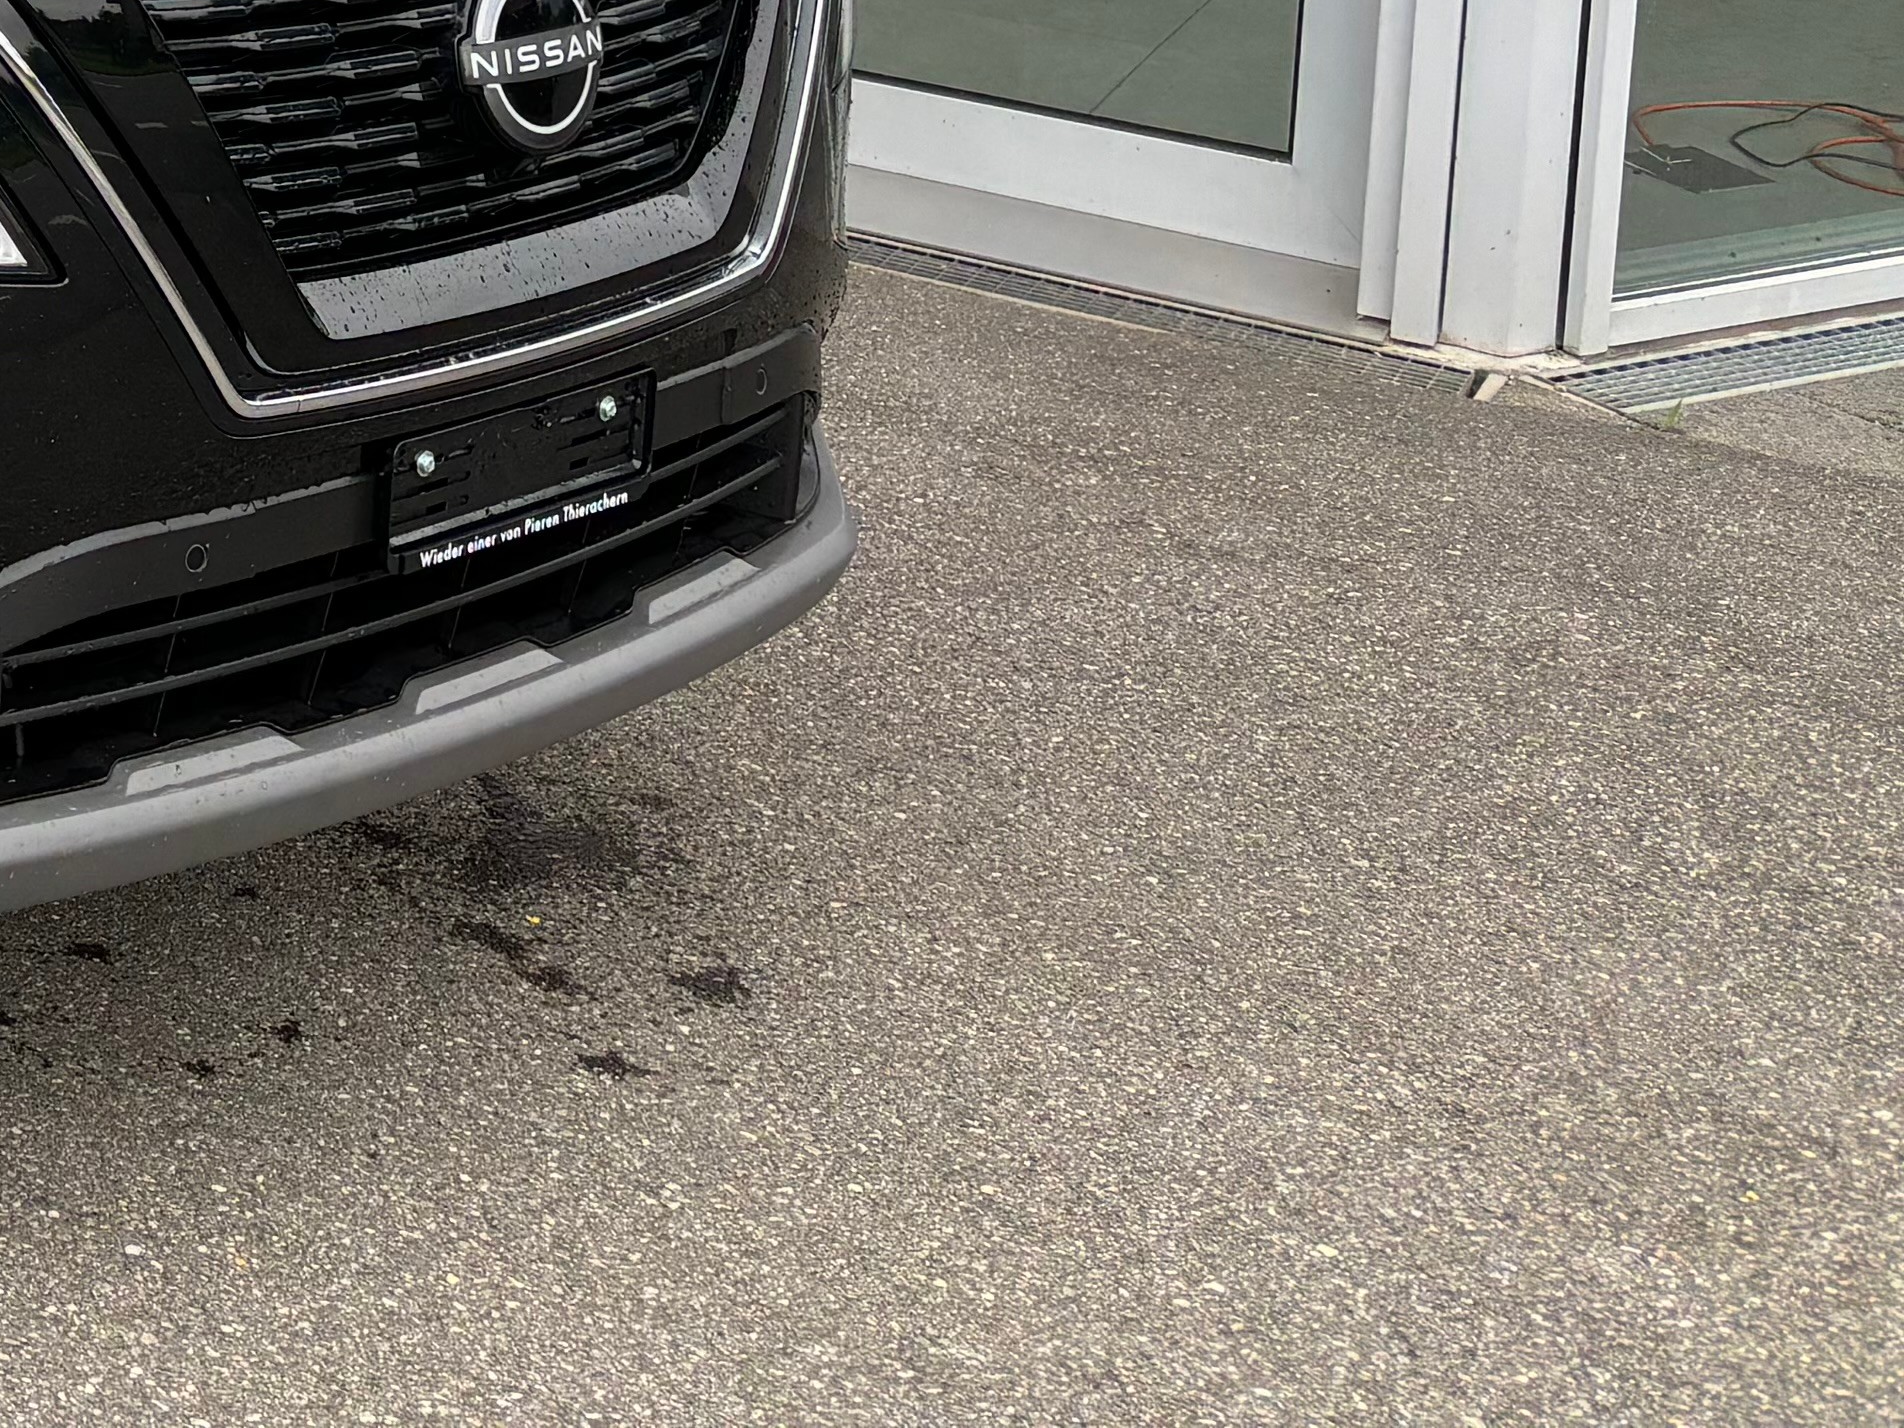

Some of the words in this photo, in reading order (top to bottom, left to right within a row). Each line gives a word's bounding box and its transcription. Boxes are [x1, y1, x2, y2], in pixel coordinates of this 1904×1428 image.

[470, 25, 603, 79] NISSAN
[419, 542, 464, 568] Wieder
[467, 533, 497, 554] einer
[500, 525, 521, 543] von
[524, 515, 560, 536] Pieren
[562, 491, 629, 523] Thierachern
